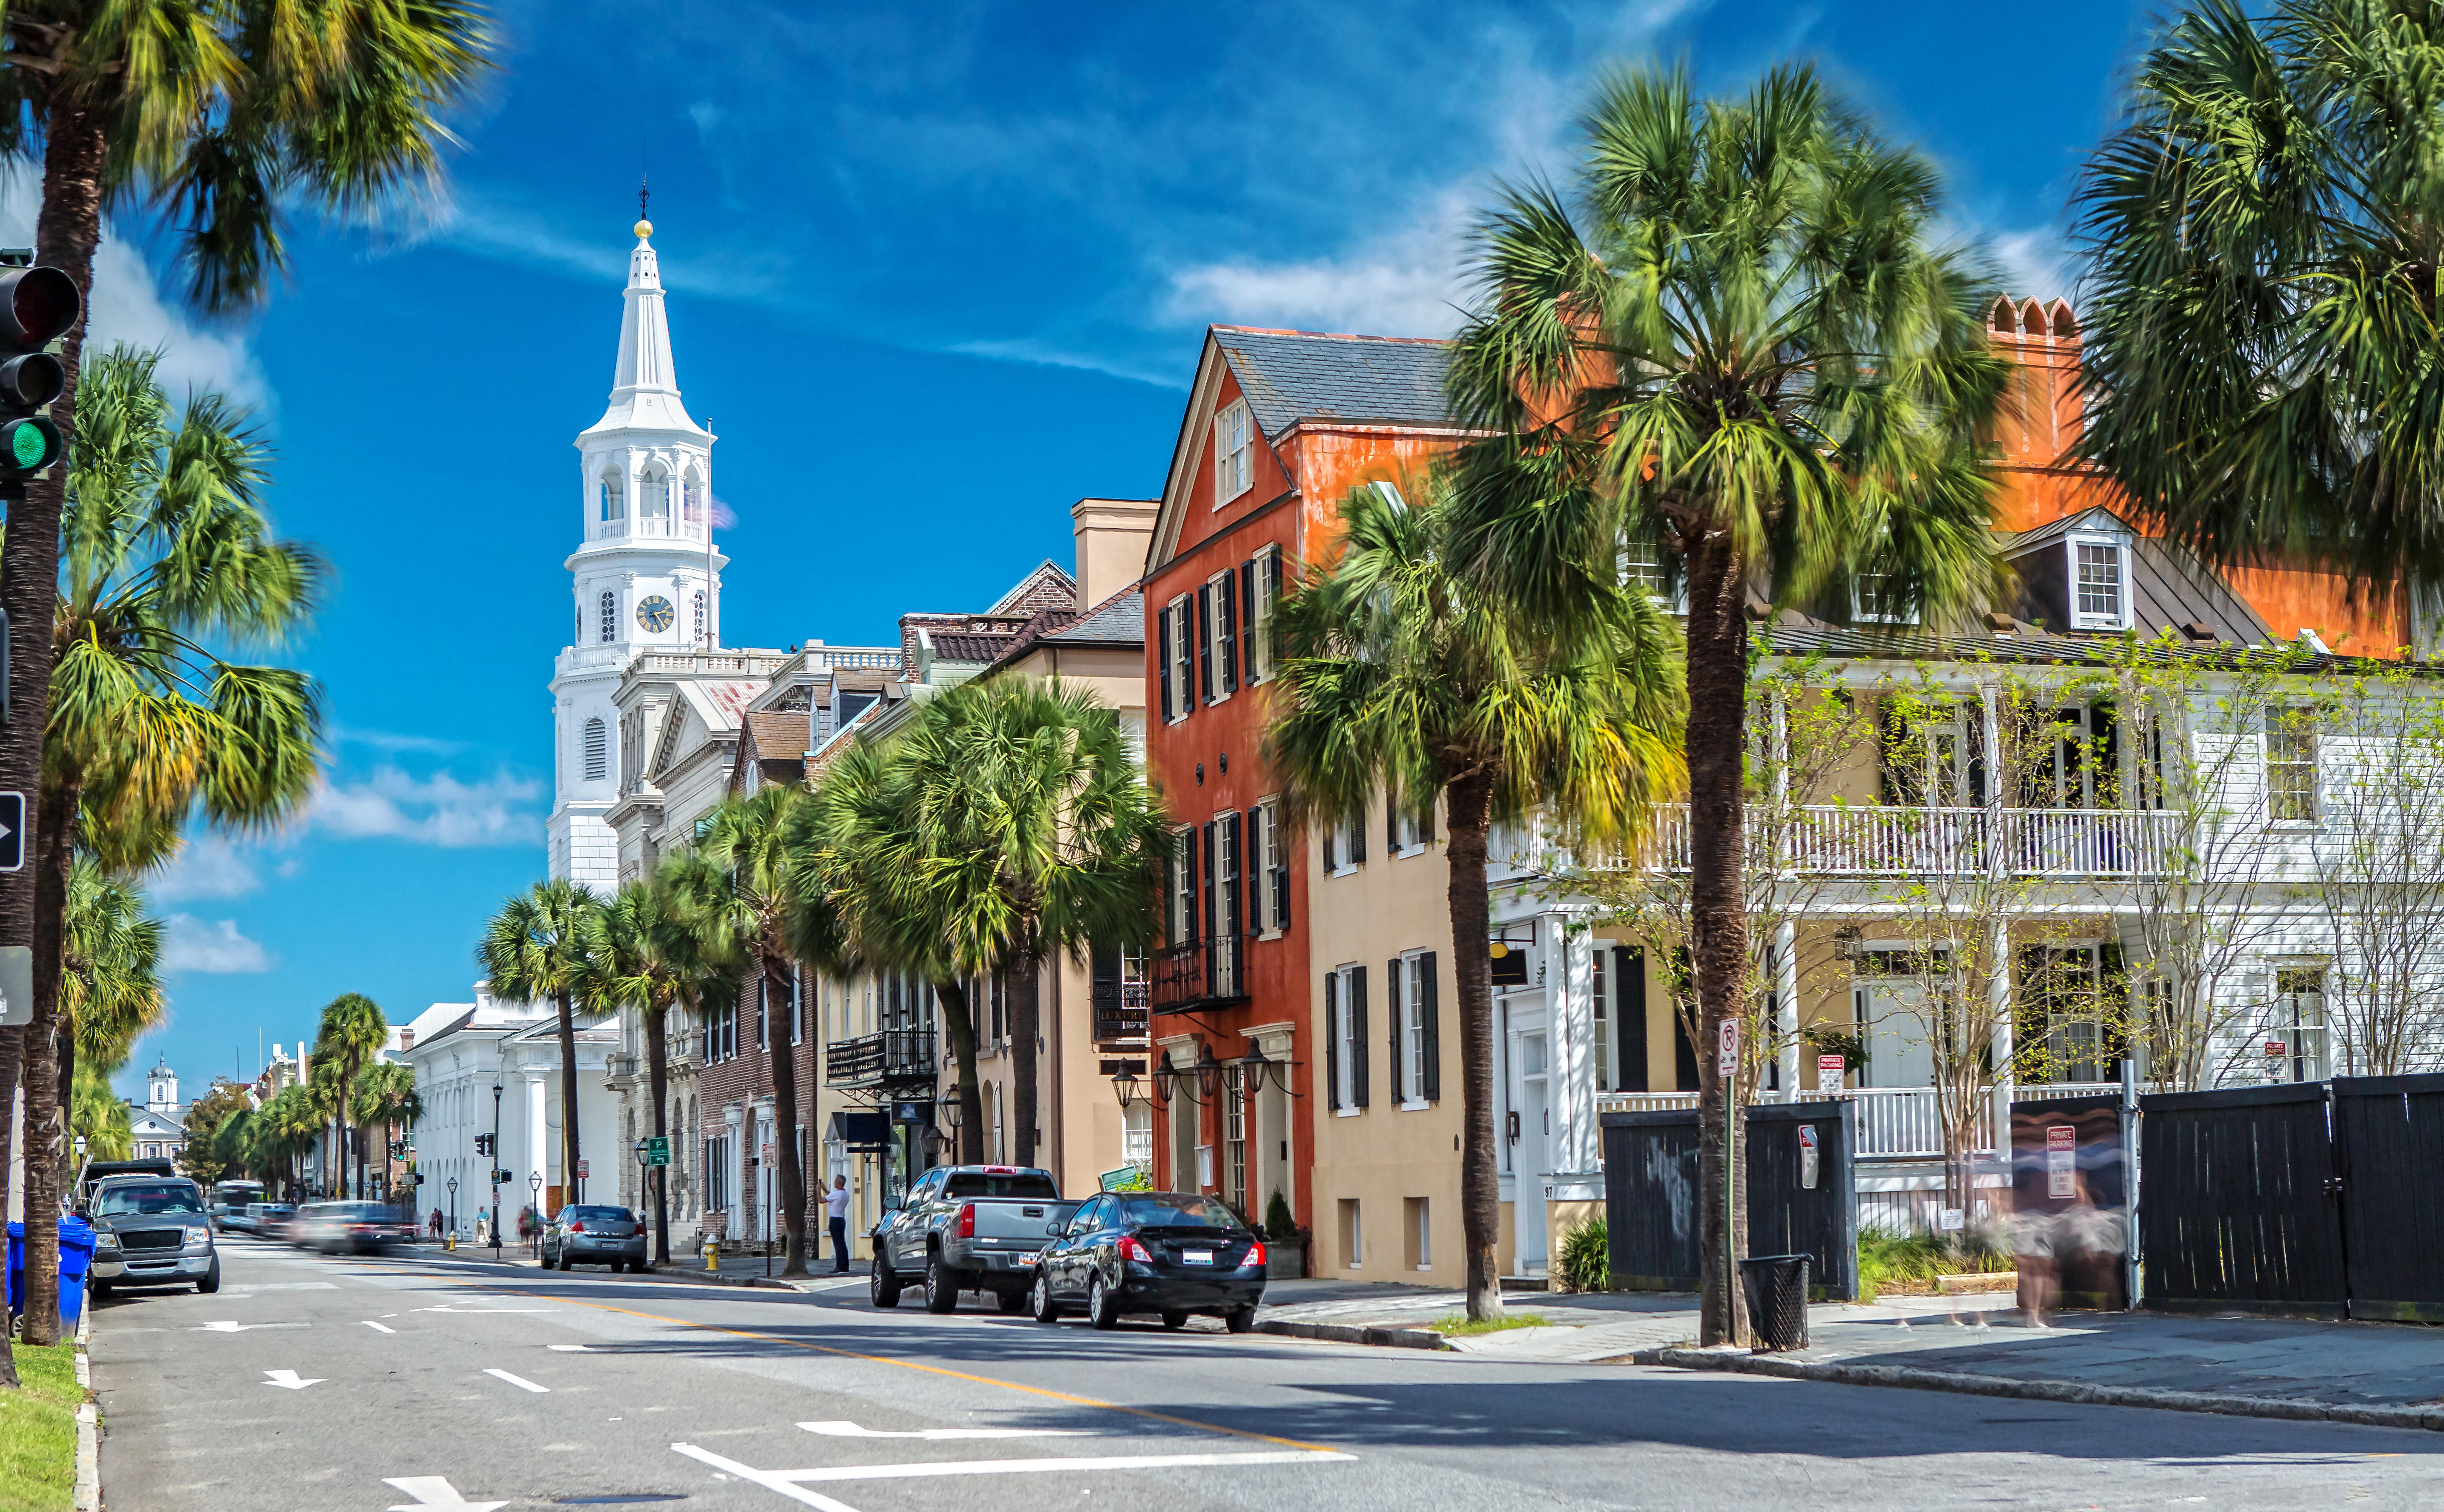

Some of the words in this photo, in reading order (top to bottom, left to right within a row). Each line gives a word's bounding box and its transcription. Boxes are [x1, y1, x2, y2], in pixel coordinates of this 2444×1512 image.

[1101, 1011, 1144, 1019] LUXURY
[2050, 1131, 2072, 1140] PRIVATE
[2049, 1140, 2073, 1148] PARKING
[1545, 1186, 1553, 1198] 97
